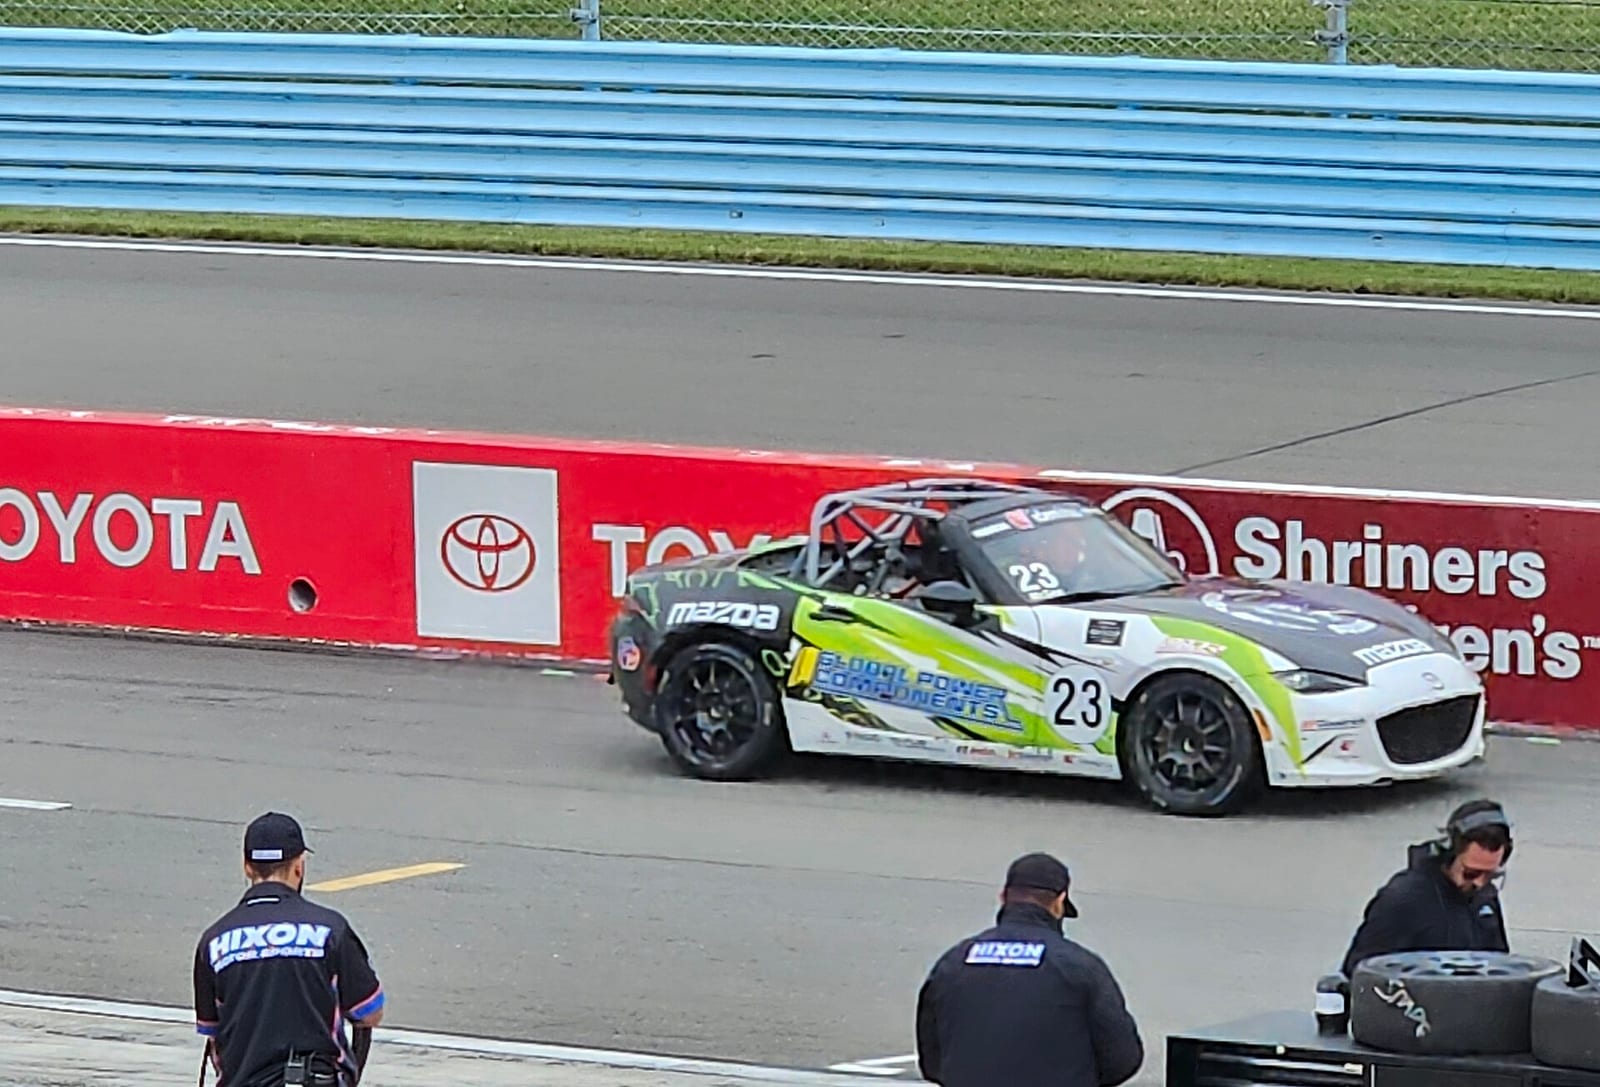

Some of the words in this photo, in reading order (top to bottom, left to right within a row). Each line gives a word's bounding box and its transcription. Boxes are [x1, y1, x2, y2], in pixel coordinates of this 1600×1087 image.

[1008, 562, 1060, 593] 23
[1234, 516, 1546, 598] Shriners
[814, 667, 1001, 720] COMPONENTS
[818, 650, 909, 683] GLOBAL
[916, 670, 1009, 702] POWER
[1052, 677, 1103, 729] 23
[208, 922, 331, 967] HIXON
[968, 942, 1045, 958] HIXON
